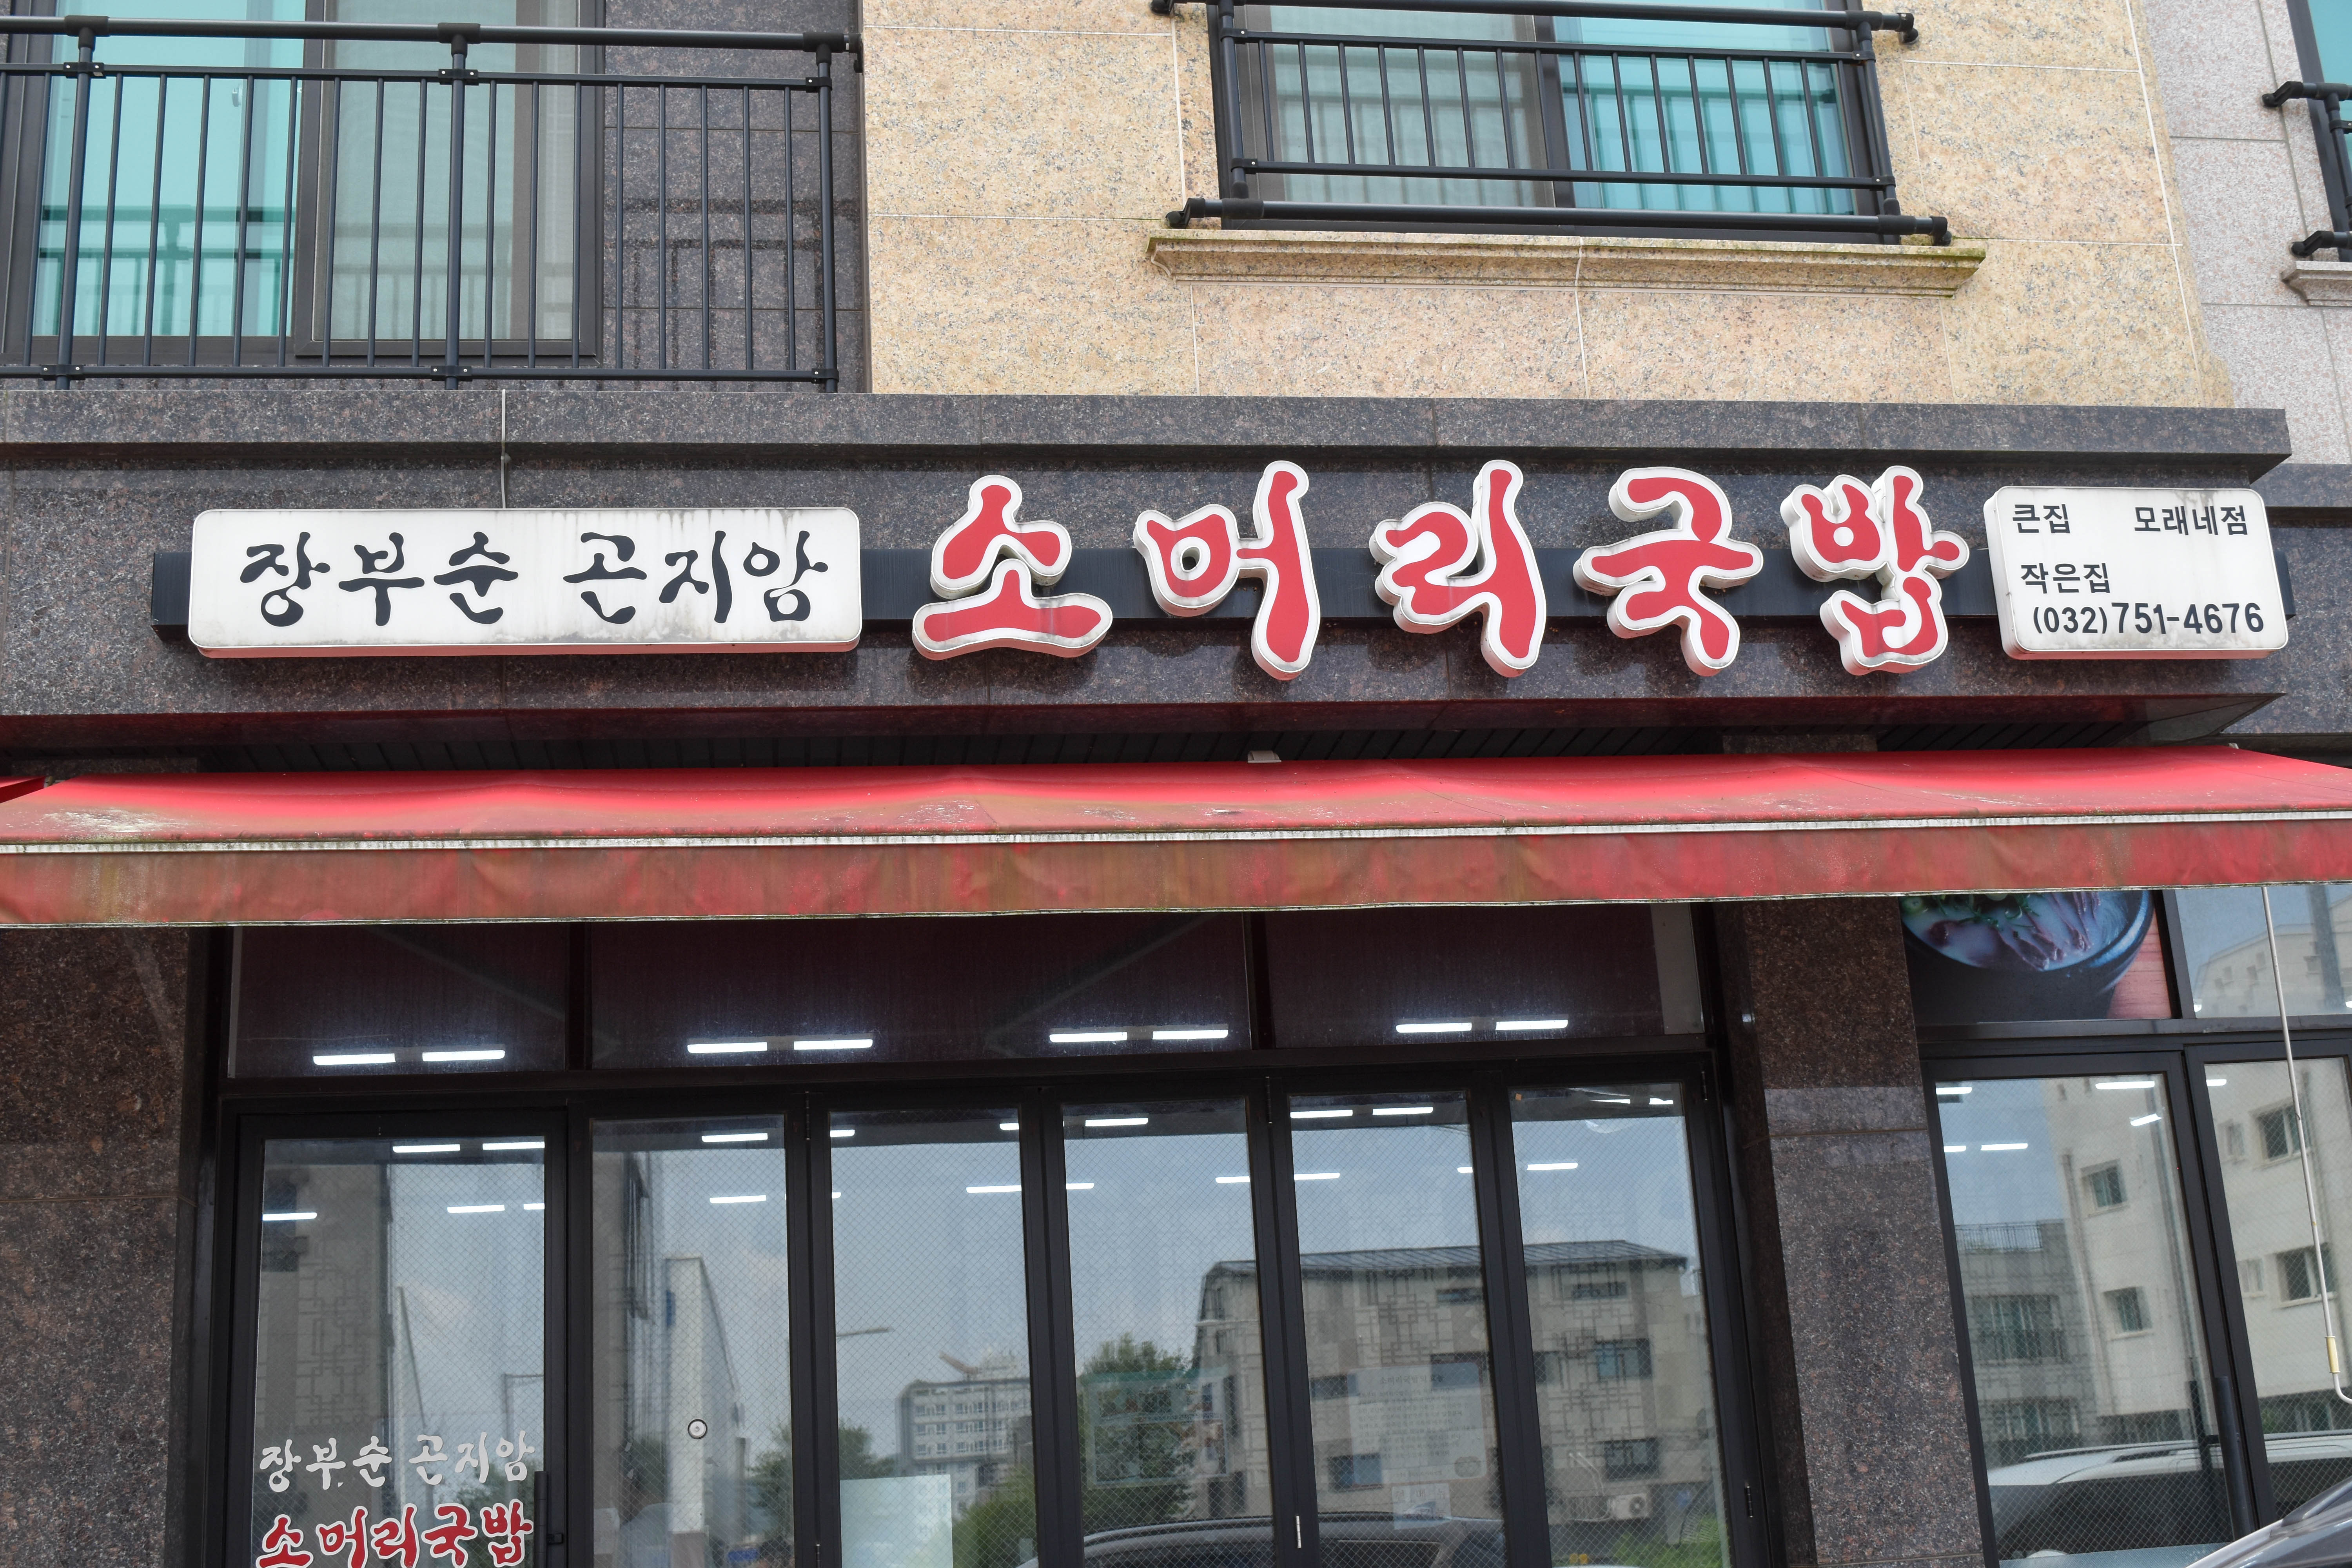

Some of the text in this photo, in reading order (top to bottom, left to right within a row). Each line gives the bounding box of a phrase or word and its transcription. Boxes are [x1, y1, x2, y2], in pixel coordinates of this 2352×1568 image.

[2012, 503, 2248, 536] 큰집 모래네점
[239, 530, 828, 627] 장부순 곤지암
[913, 460, 1969, 680] 소머리국밥
[2020, 562, 2111, 594] 작은집
[2033, 602, 2264, 635] (032)751-4676
[259, 1430, 535, 1492] 장부순 곤지암
[256, 1498, 534, 1568] 소머리국밥
